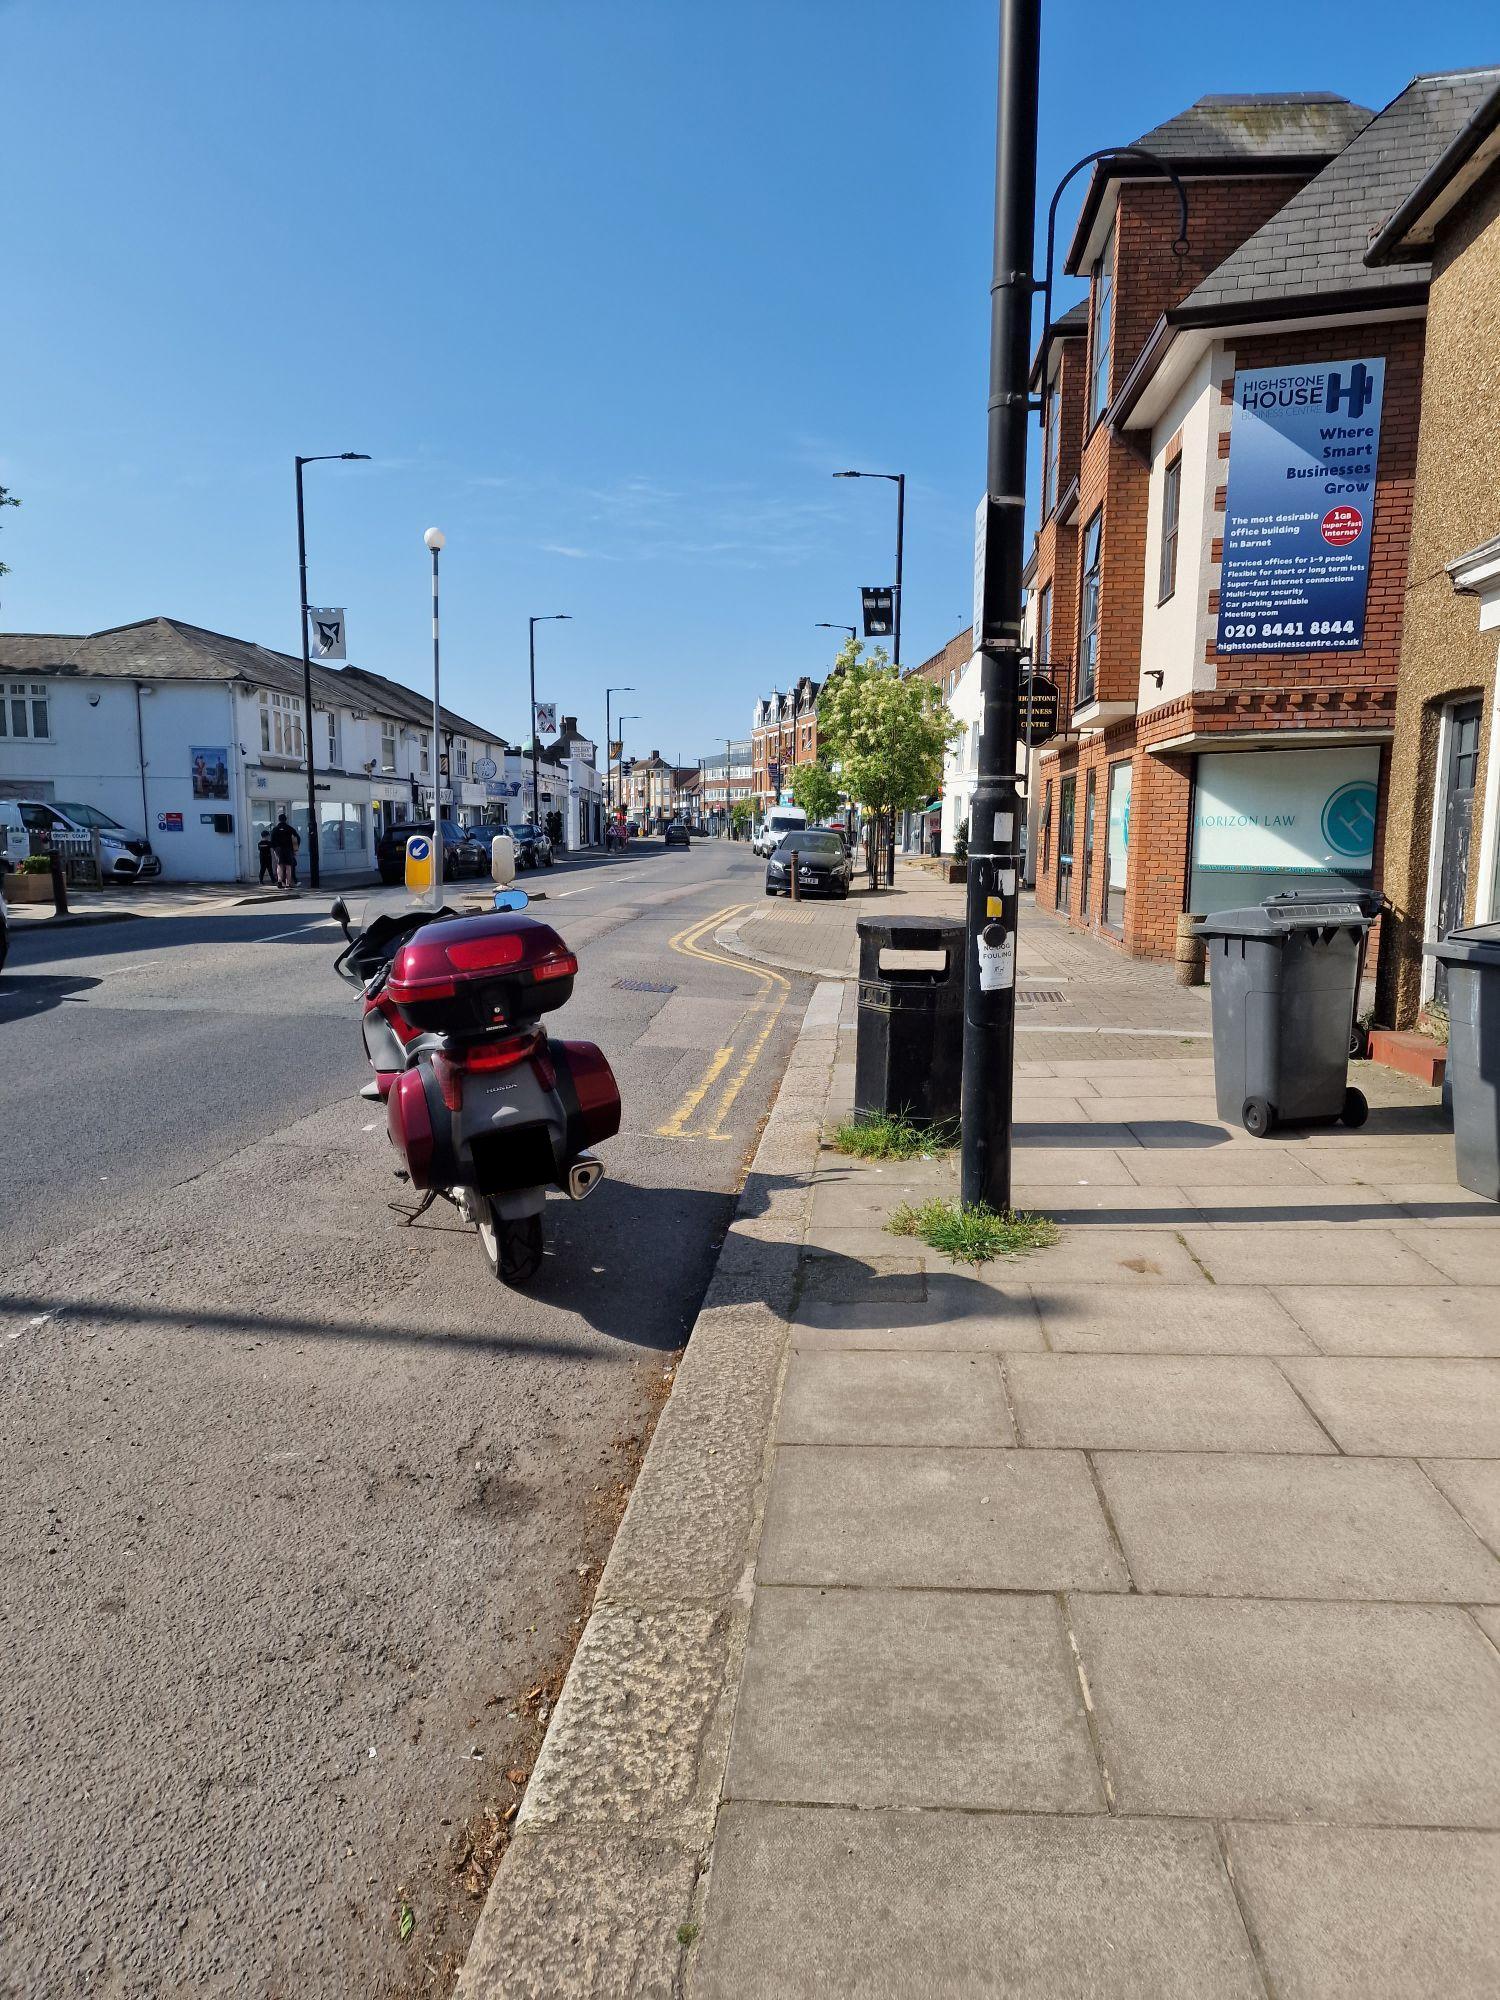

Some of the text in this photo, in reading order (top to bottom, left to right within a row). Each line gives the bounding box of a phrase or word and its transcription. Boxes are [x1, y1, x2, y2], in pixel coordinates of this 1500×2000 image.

[1243, 374, 1324, 392] HIGHSTONE
[1242, 386, 1324, 411] HOUSE
[1241, 404, 1322, 421] BUSINESS CENTRE
[1319, 427, 1374, 440] Where
[1322, 443, 1373, 458] Smart
[1286, 464, 1371, 479] Businesses
[1324, 482, 1370, 494] Grow
[1231, 511, 1320, 525] The most desirable
[1322, 520, 1362, 529] super-fast
[1230, 525, 1300, 537] office building
[1229, 538, 1272, 549] in Barnet
[1228, 553, 1353, 568] Serviced offices for 1-9 people
[1227, 563, 1365, 578] Flexible for short or long term lets
[1226, 579, 1270, 589] Super-fast
[1305, 574, 1355, 584] connections
[1226, 587, 1304, 599] Multi-layer security
[1225, 596, 1309, 609] Car parking available
[1224, 608, 1279, 619] Meeting room
[1224, 619, 1355, 638] 020 8441 8844
[1196, 814, 1259, 828] HORIZON
[1264, 814, 1296, 827] LAW
[983, 950, 1012, 960] FOULING
